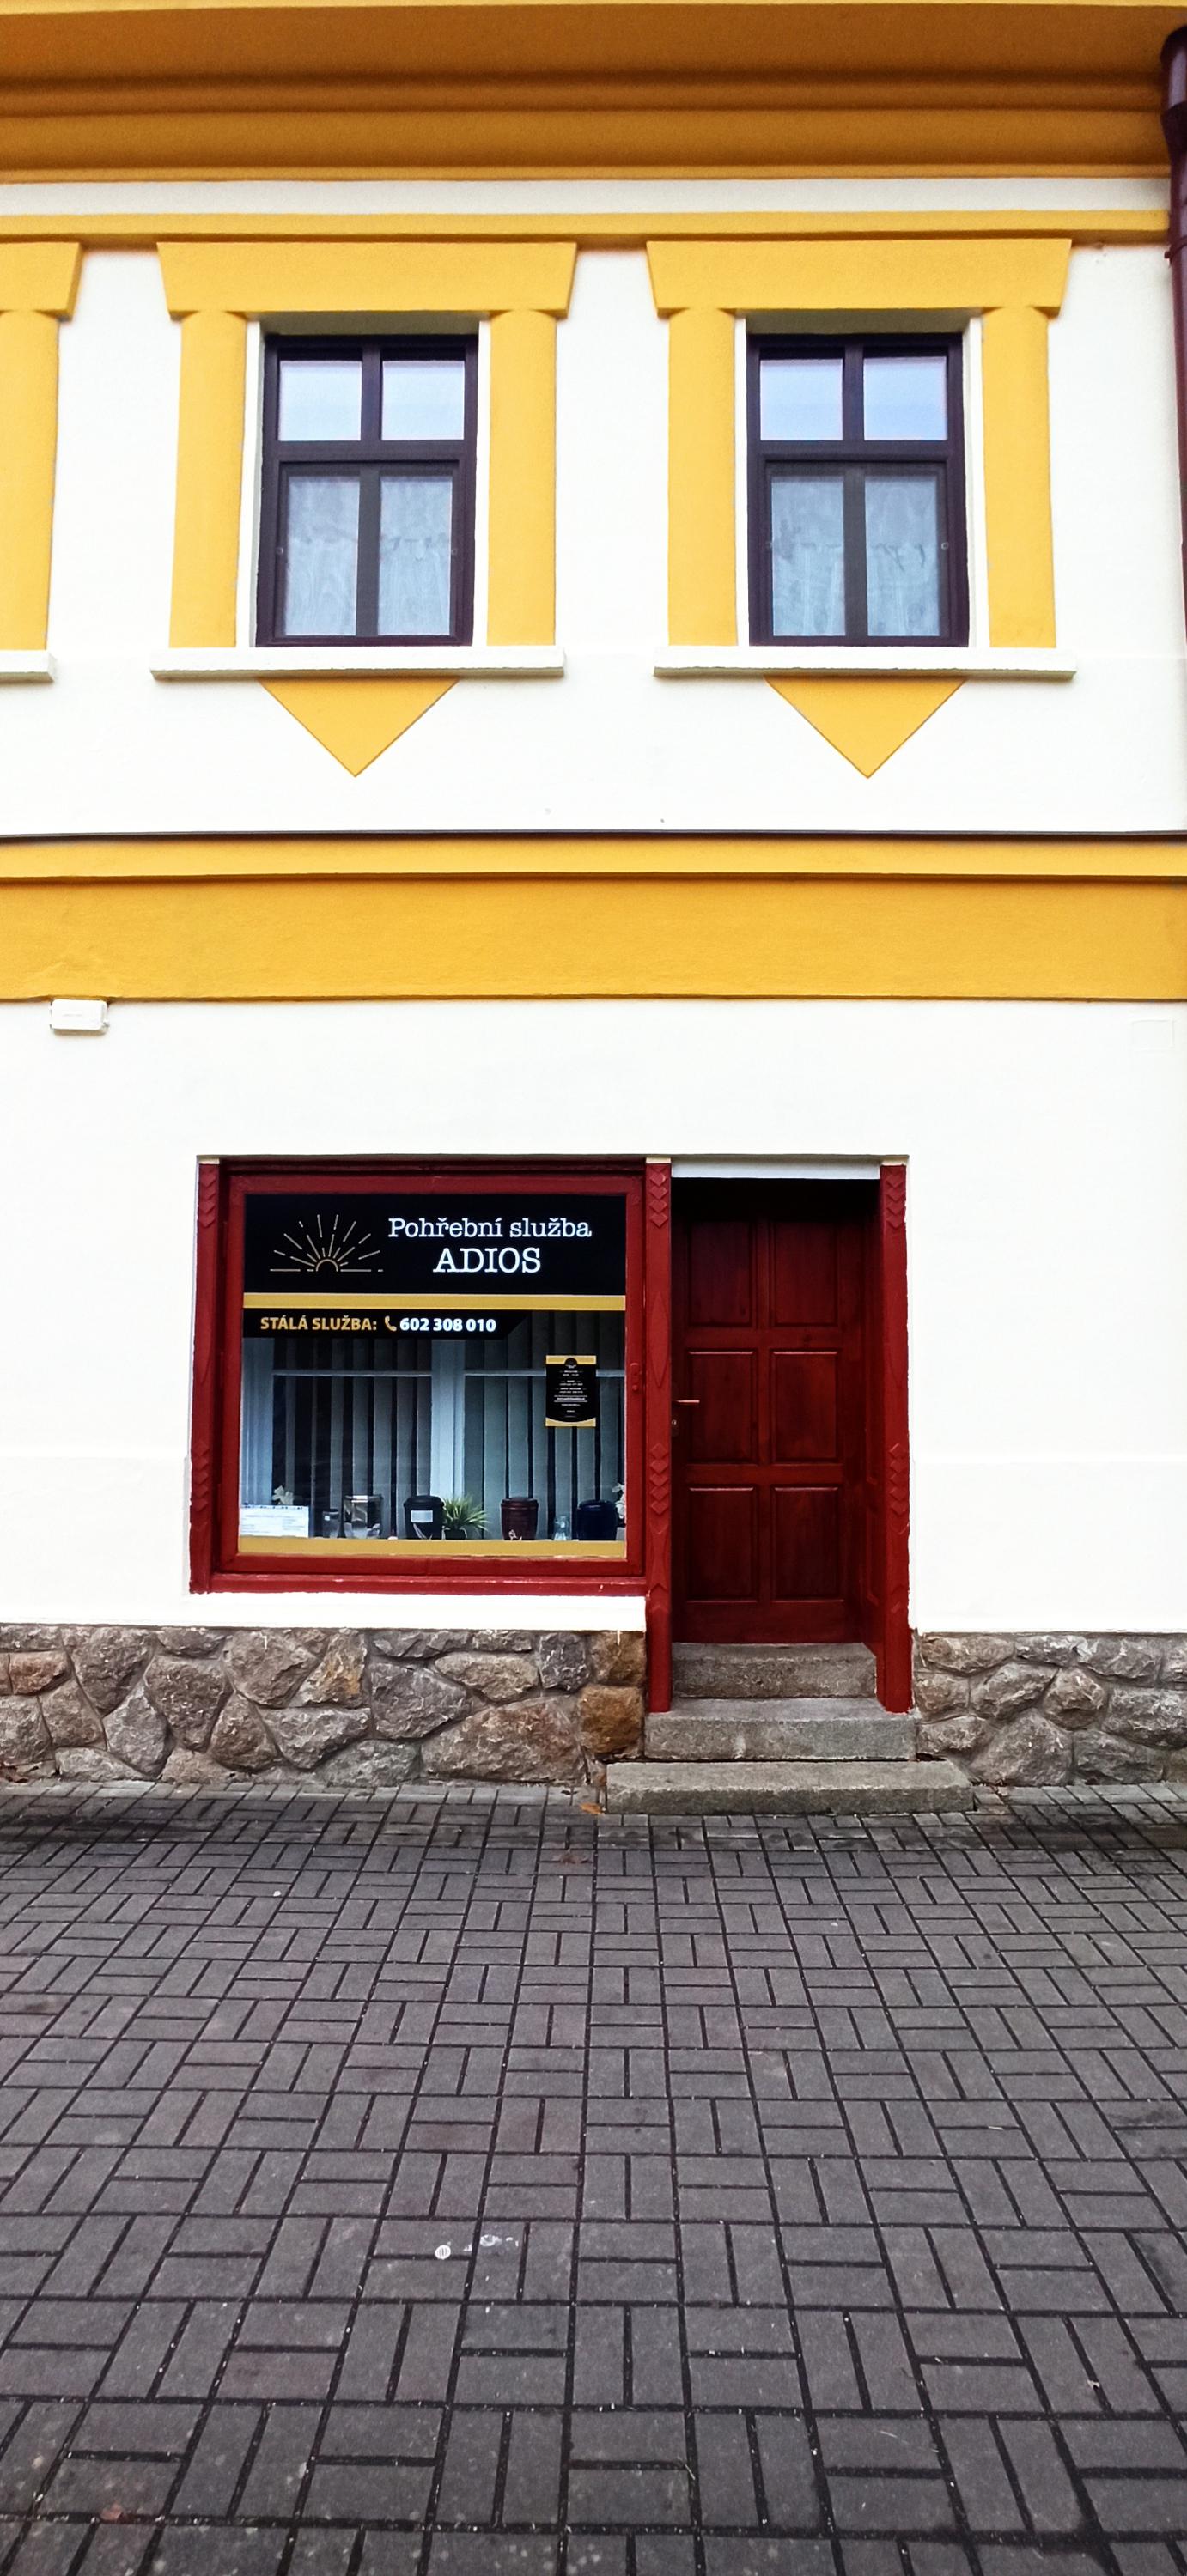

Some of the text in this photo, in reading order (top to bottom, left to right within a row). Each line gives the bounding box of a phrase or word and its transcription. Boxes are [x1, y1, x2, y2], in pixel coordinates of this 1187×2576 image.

[387, 1217, 593, 1238] Pohřební služba
[432, 1246, 541, 1273] ADIOS
[260, 1315, 496, 1333] STÁLÁ SLUŽBA: 602 308 010
